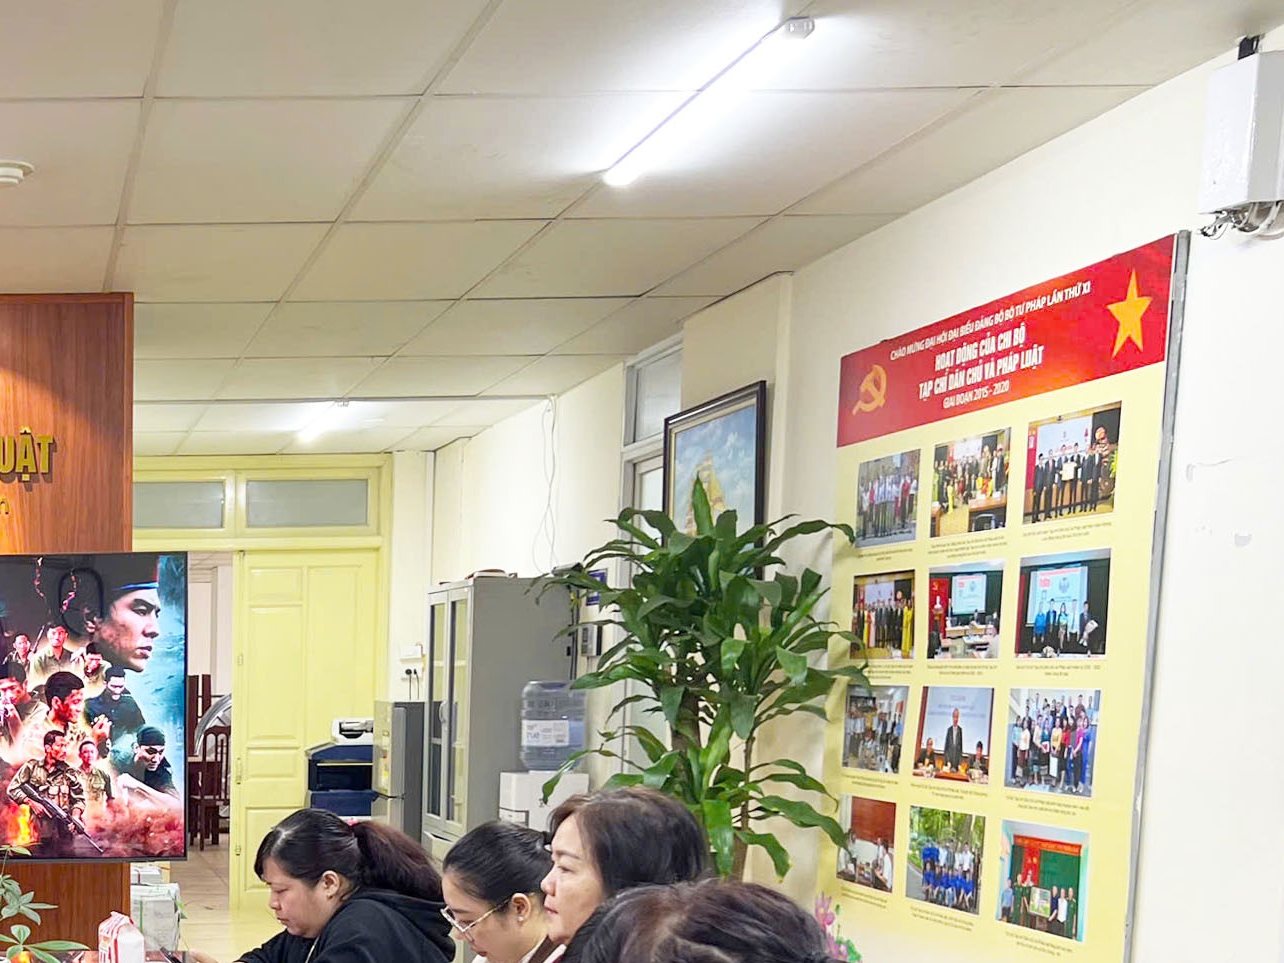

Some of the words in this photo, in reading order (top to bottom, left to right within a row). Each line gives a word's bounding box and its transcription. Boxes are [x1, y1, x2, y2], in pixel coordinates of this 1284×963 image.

[1025, 295, 1047, 313] PHÁP
[1081, 280, 1092, 295] XI
[935, 349, 957, 375] HOẠT
[955, 342, 979, 366] ĐỘNG
[978, 331, 997, 357] CỦA
[997, 329, 1013, 352] CHI
[1012, 321, 1027, 348] BỘ
[918, 380, 934, 402] TẠP
[933, 368, 948, 395] CHÍ
[947, 368, 966, 391] DÂN
[966, 359, 984, 386] CHỦ
[983, 357, 997, 380] VÀ
[996, 350, 1020, 377] PHÁP
[1019, 343, 1045, 370] LUẬT
[973, 385, 990, 401] 2015
[992, 379, 1011, 396] 2020
